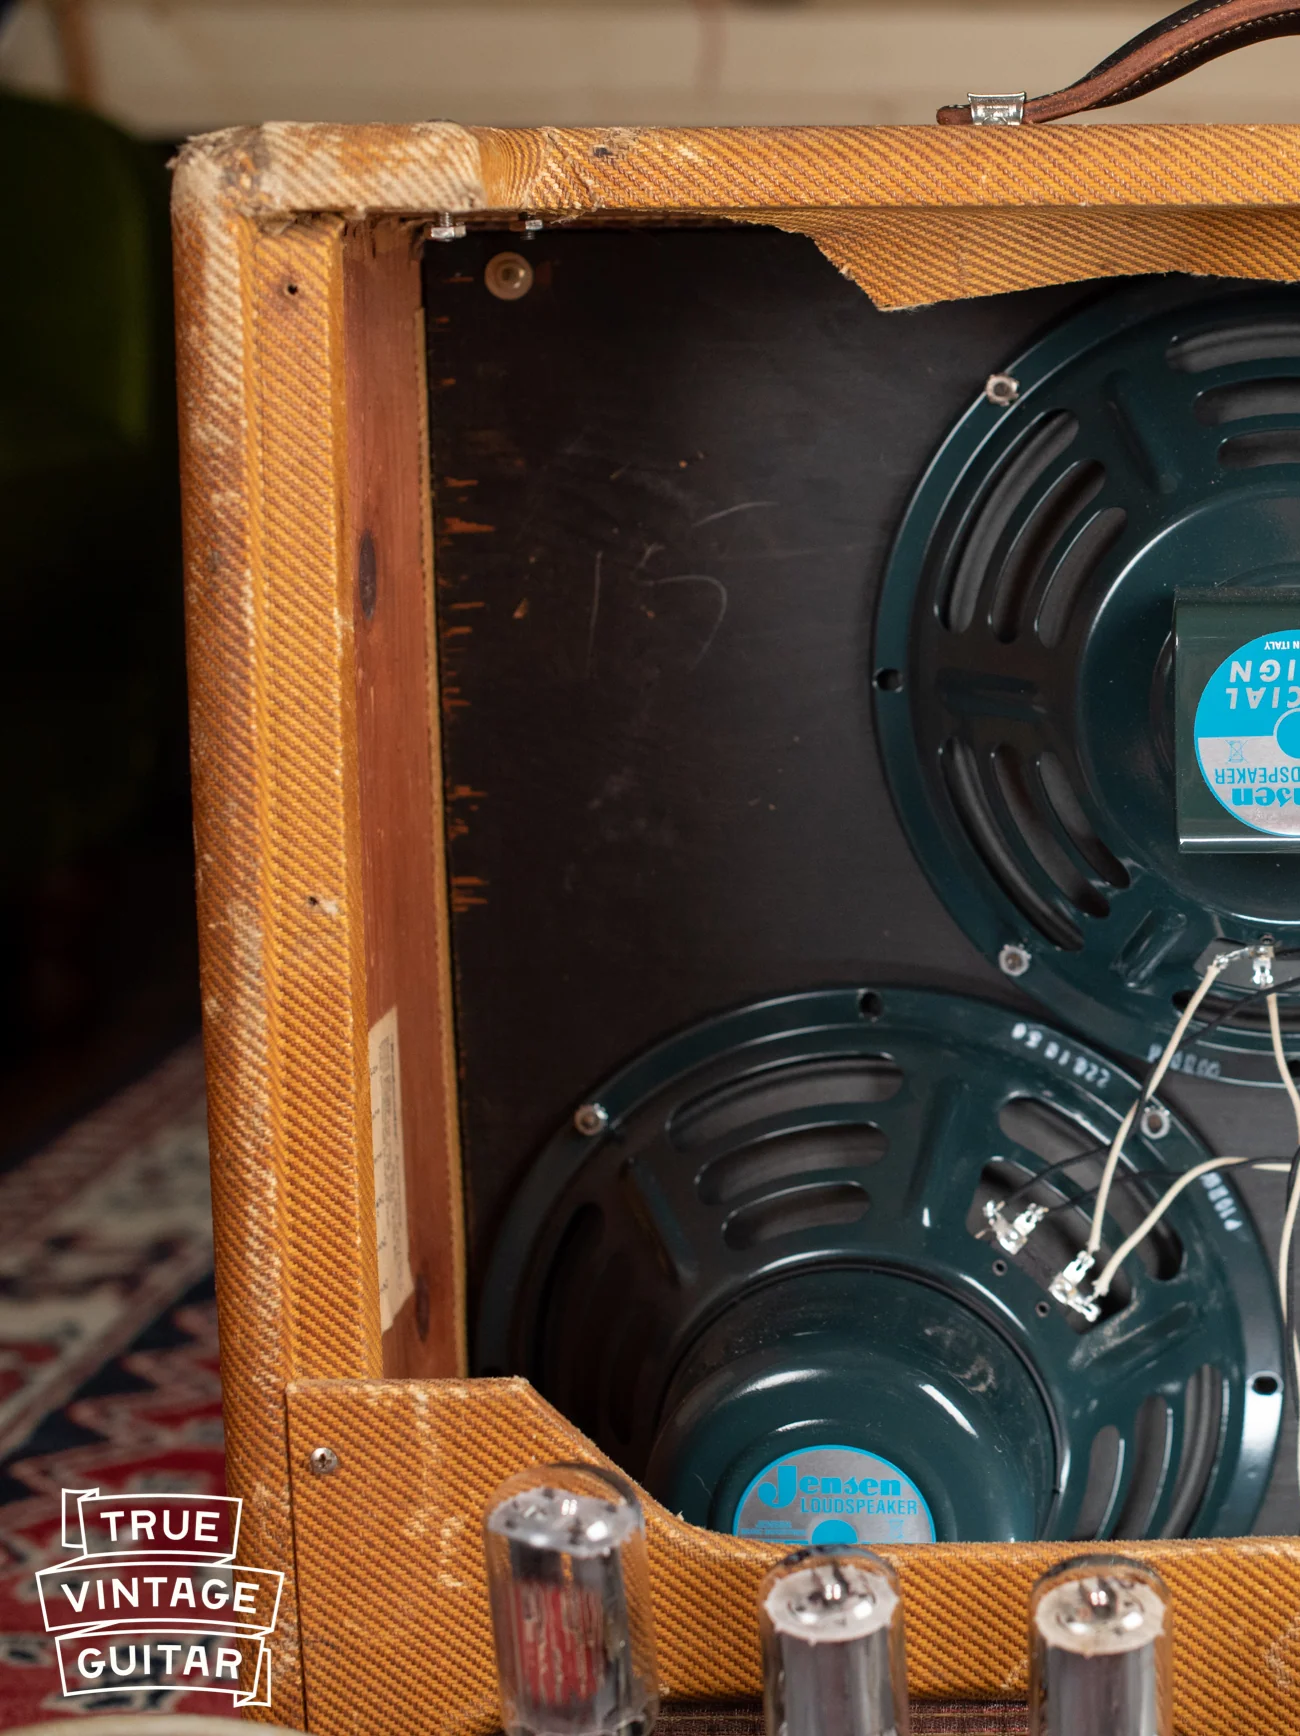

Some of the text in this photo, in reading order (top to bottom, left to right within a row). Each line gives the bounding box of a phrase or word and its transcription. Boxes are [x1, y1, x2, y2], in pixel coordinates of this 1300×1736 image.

[1264, 641, 1290, 650] ITALY
[758, 1465, 901, 1509] Jensen
[801, 1498, 918, 1515] LOUDSPEAKER
